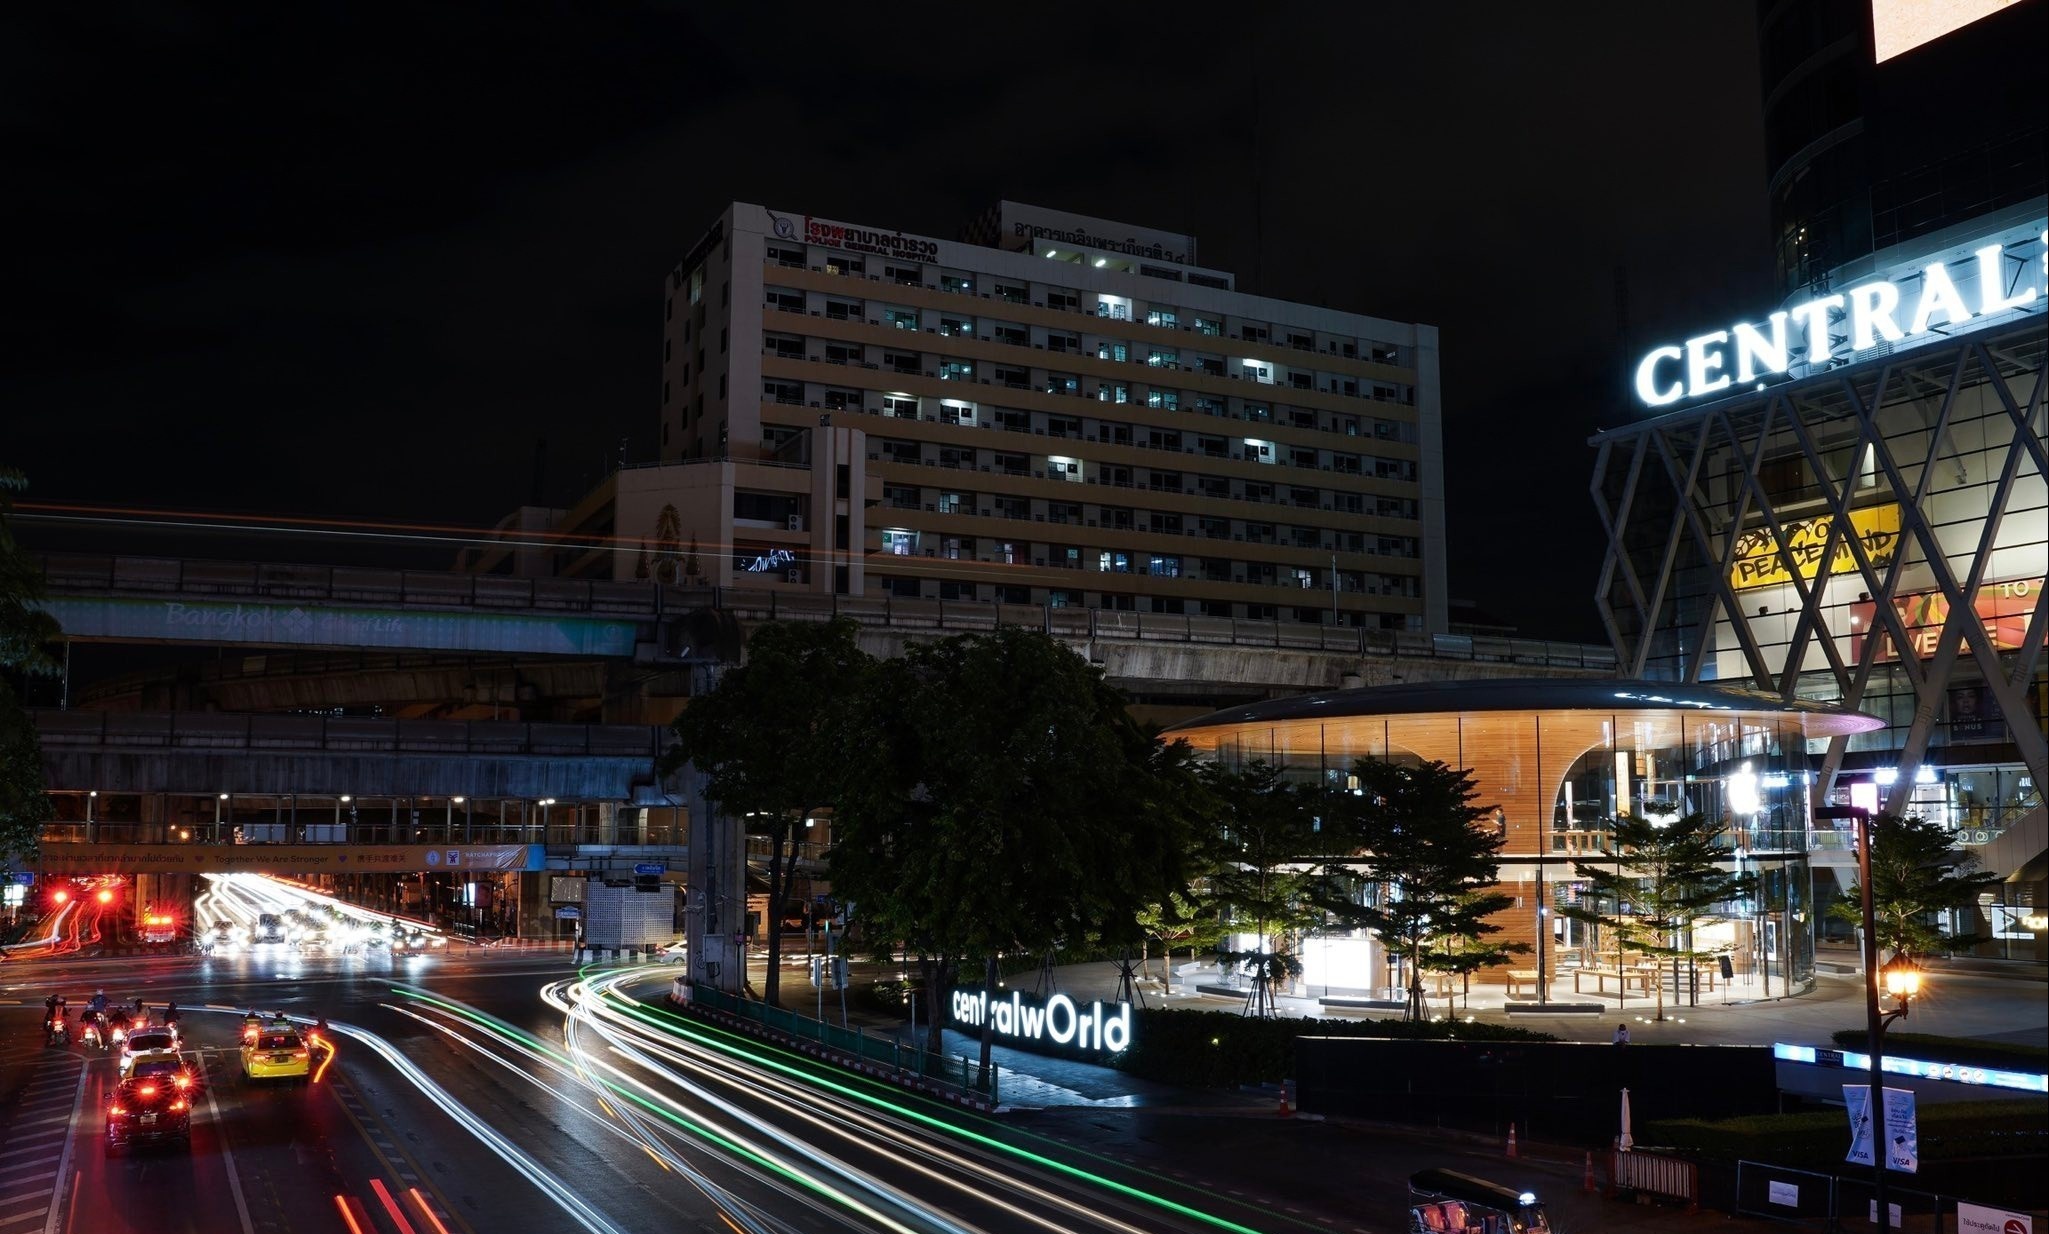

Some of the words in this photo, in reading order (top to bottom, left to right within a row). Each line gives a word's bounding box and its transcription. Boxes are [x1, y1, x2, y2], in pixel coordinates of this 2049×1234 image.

[804, 215, 938, 255] โรงพยาบาลตำรวจ
[804, 235, 841, 248] POLICE
[844, 241, 889, 256] GENERAL
[893, 249, 938, 264] HOSPITAL
[1635, 244, 2037, 406] CENTRAL
[2000, 582, 2030, 600] TO
[165, 602, 276, 634] Bangkok
[215, 855, 256, 865] Together
[257, 855, 271, 863] We
[272, 855, 288, 863] Are
[290, 855, 328, 865] Stronger
[1852, 1150, 1869, 1159] VISA
[1893, 1157, 1910, 1166] VISA
